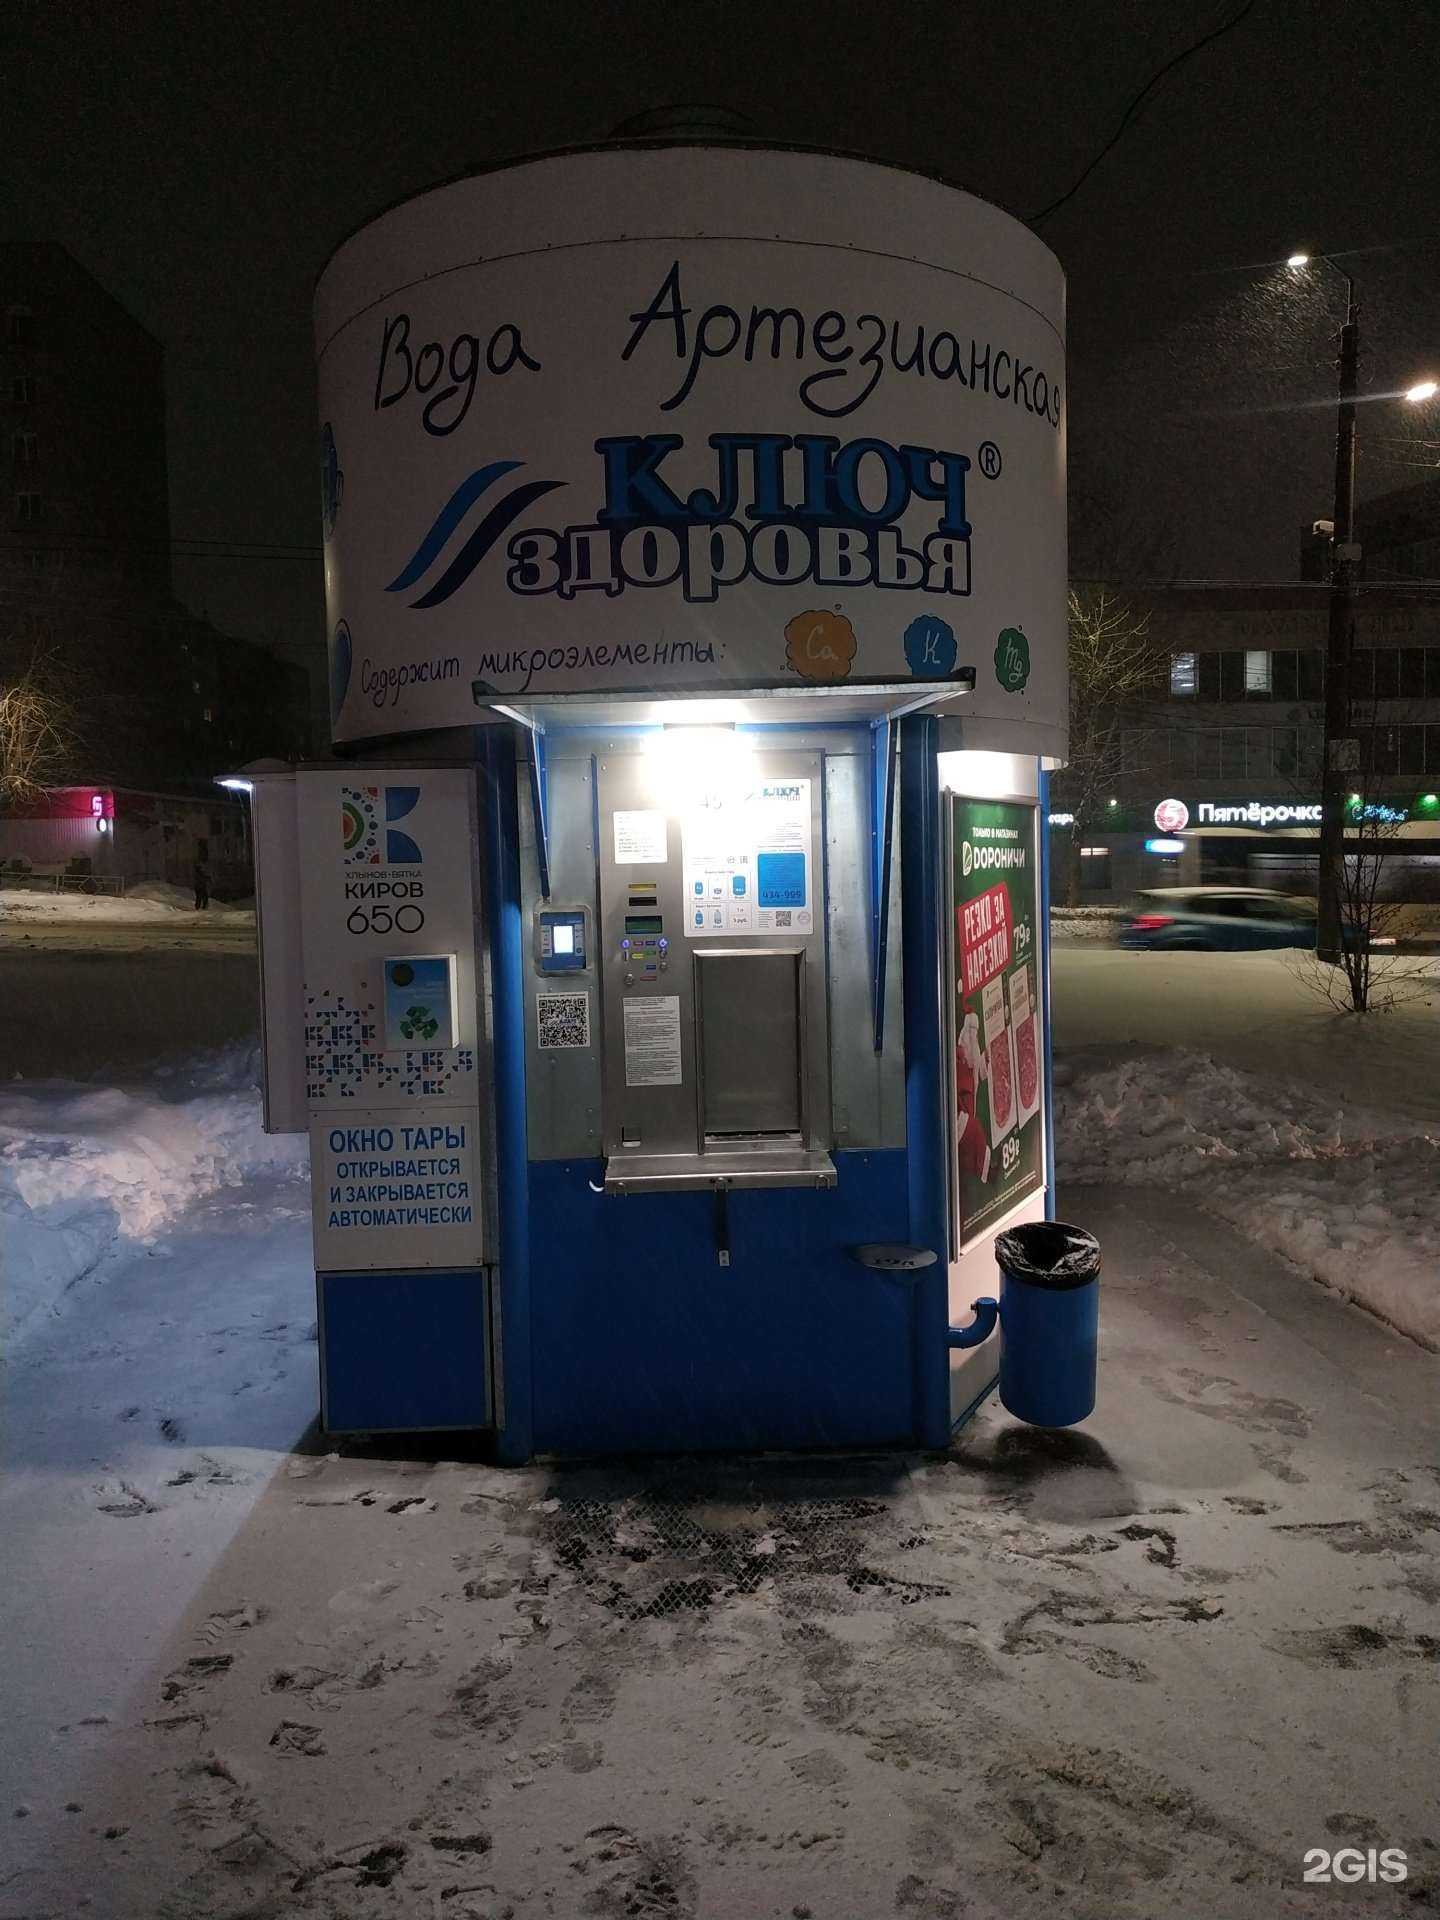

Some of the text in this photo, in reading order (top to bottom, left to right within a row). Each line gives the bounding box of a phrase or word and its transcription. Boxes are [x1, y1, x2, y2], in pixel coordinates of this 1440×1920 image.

[374, 260, 1062, 436] Вода Артезианская
[594, 433, 972, 537] КЛЮЧ
[361, 640, 727, 708] Содержит микроэлементы:
[345, 882, 424, 899] КИРОВ
[347, 904, 425, 934] 650
[964, 892, 1006, 947] РЕЗКО ЗА
[966, 921, 1009, 991] НАРЕЗКОЙ
[329, 1125, 466, 1153] ОКНО ТАРЫ
[337, 1158, 460, 1179] ОТКРЫВАЕТСЯ
[330, 1182, 469, 1203] И ЗАКРЫВАЕТСЯ
[328, 1206, 472, 1228] АВТОМАТИЧЕСКИ
